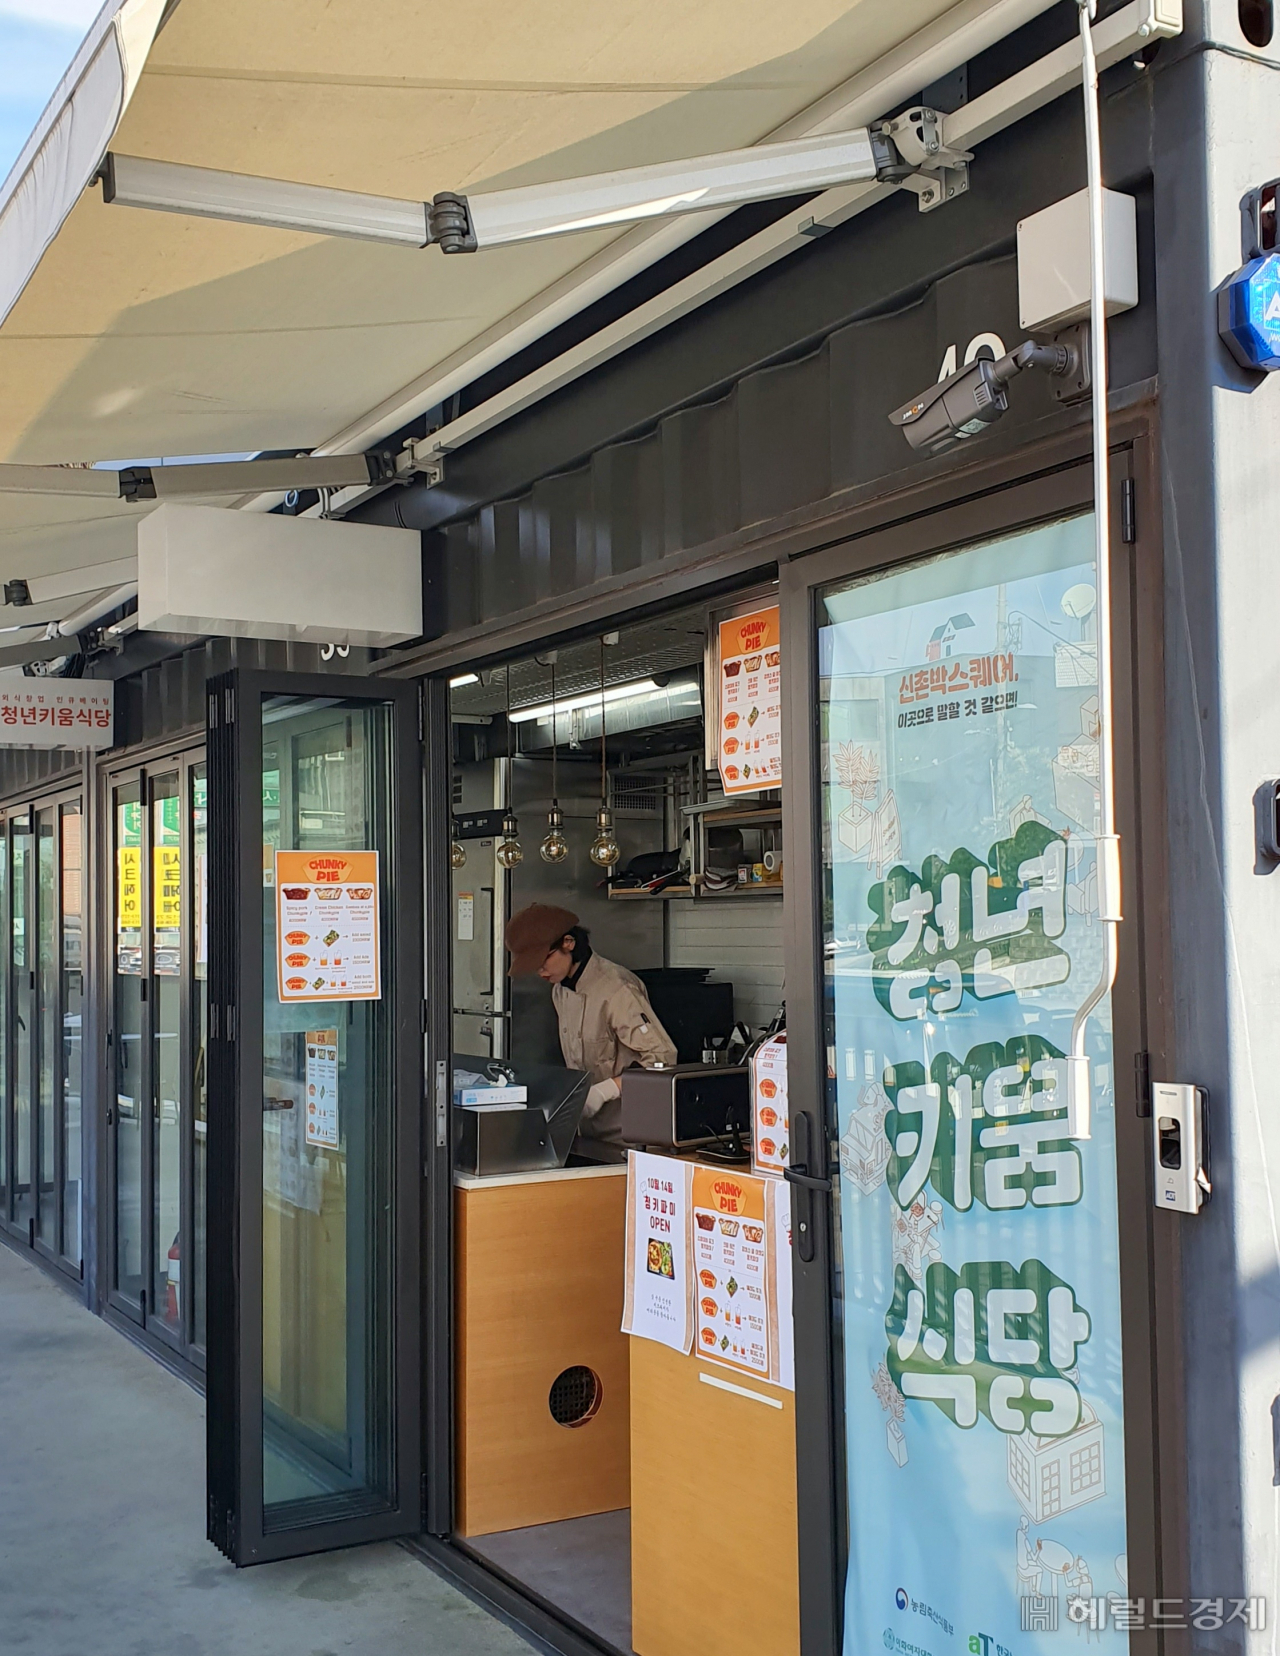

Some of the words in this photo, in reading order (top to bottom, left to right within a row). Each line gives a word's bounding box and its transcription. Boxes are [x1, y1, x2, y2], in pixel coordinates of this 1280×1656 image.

[740, 621, 767, 639] CHUNKY
[745, 636, 761, 651] PIE
[899, 652, 1019, 704] 신촌박스퀘어,
[1, 706, 111, 728] 청년키움식당
[897, 707, 935, 729] 이곳으로
[937, 701, 961, 722] 말할
[964, 698, 978, 717] 것
[309, 859, 347, 870] CHUNKY
[316, 871, 340, 882] PIE
[885, 838, 1072, 1021] 청년
[895, 1057, 1084, 1211] 키움
[714, 1182, 742, 1199] CHUNKY
[720, 1196, 738, 1213] PIE
[650, 1215, 671, 1233] OPEN
[896, 1285, 1092, 1437] 식당
